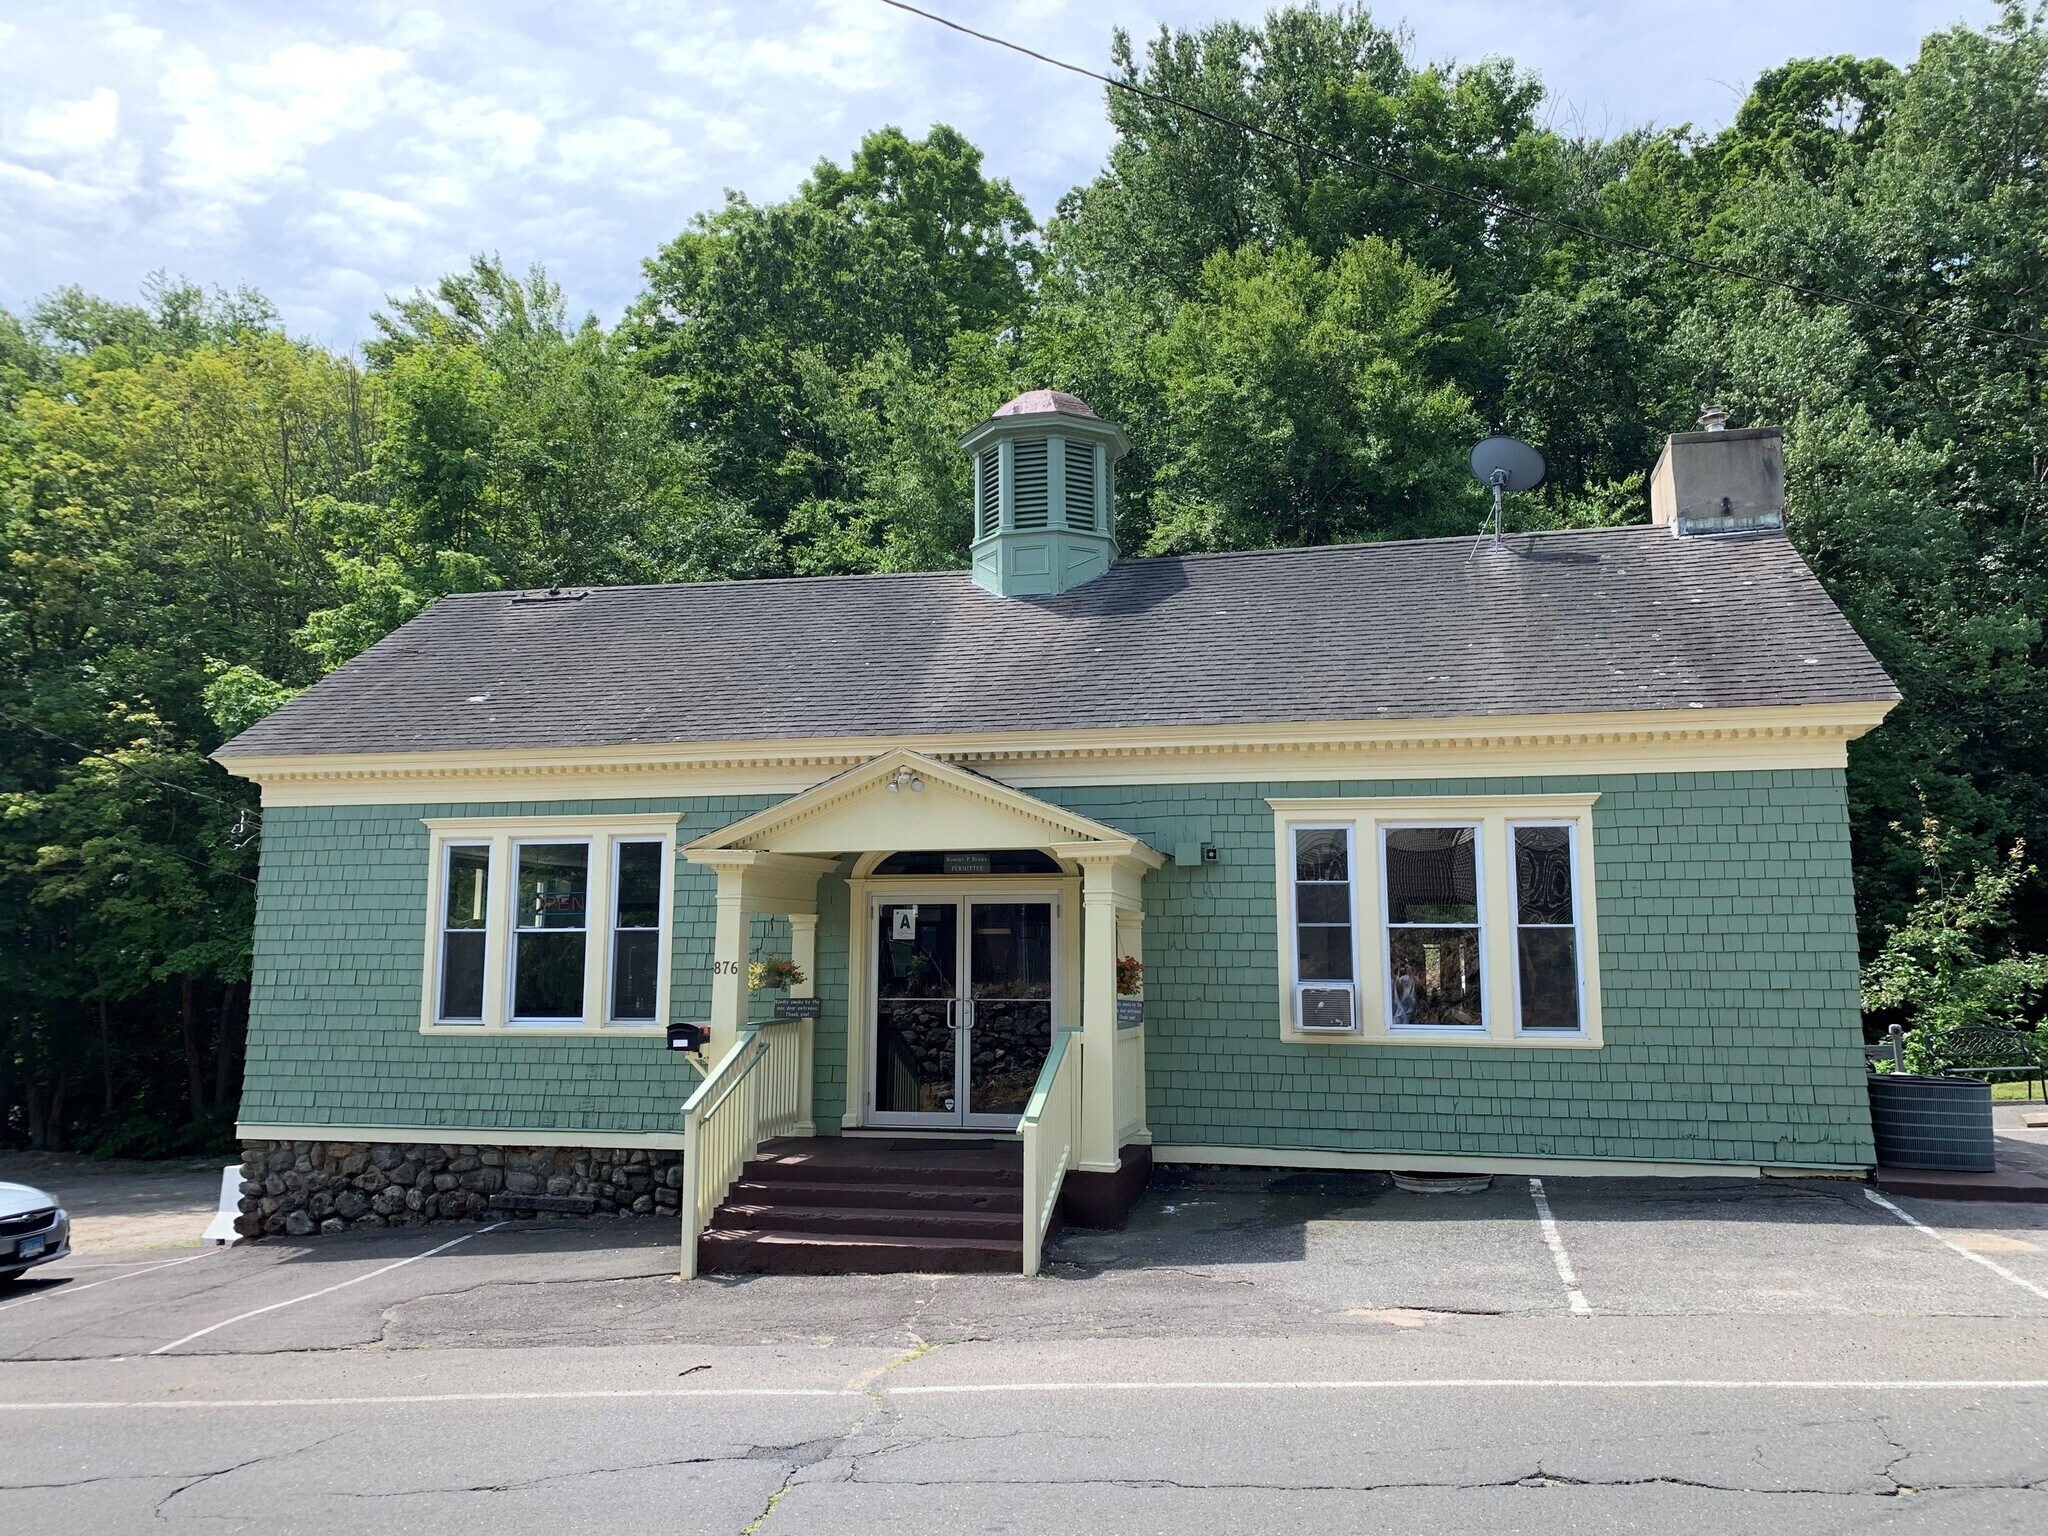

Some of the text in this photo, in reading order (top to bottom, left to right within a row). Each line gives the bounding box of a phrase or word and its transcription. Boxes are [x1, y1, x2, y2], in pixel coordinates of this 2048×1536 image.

[528, 894, 584, 911] OPEN
[899, 914, 911, 929] A
[714, 961, 739, 975] 876
